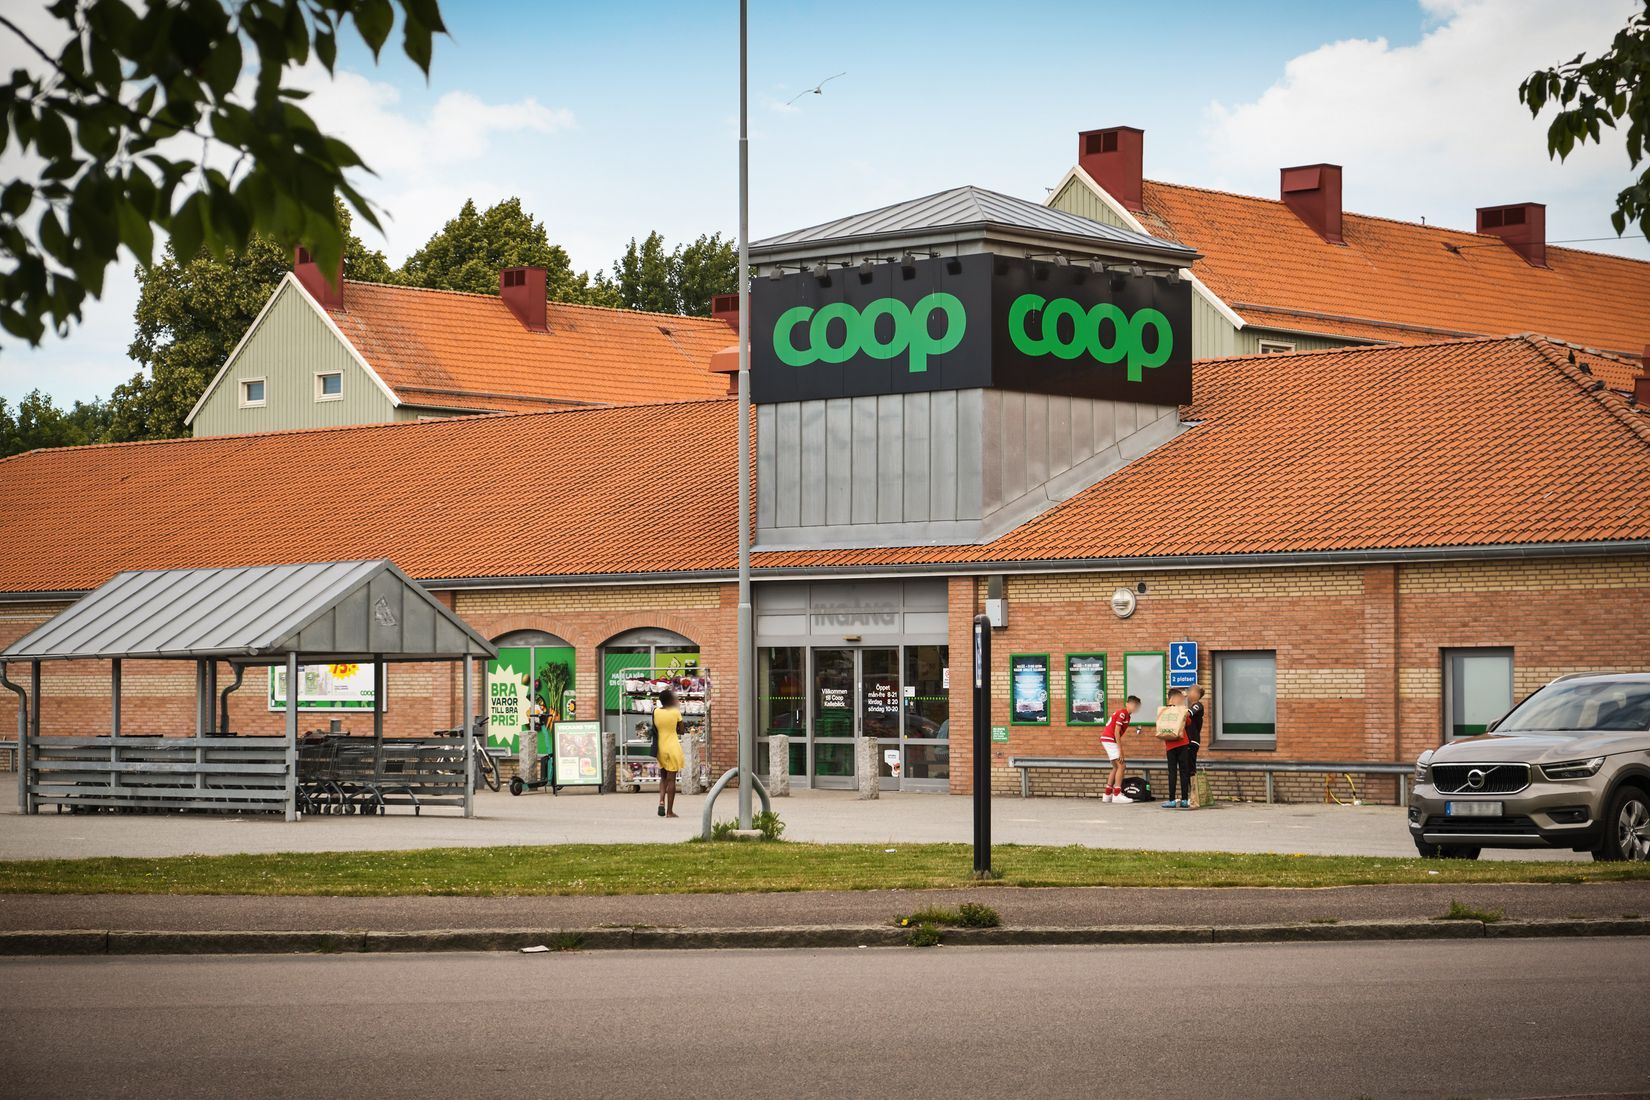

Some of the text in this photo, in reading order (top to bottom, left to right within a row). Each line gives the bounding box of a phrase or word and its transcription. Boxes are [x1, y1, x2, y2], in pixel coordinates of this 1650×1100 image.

[773, 292, 966, 373] coop
[1008, 293, 1173, 382] coop
[814, 598, 895, 627] INGÅNG
[491, 682, 517, 696] BRA
[875, 683, 890, 691] Öppet
[491, 697, 518, 706] VAROR
[491, 714, 518, 726] PRIS!
